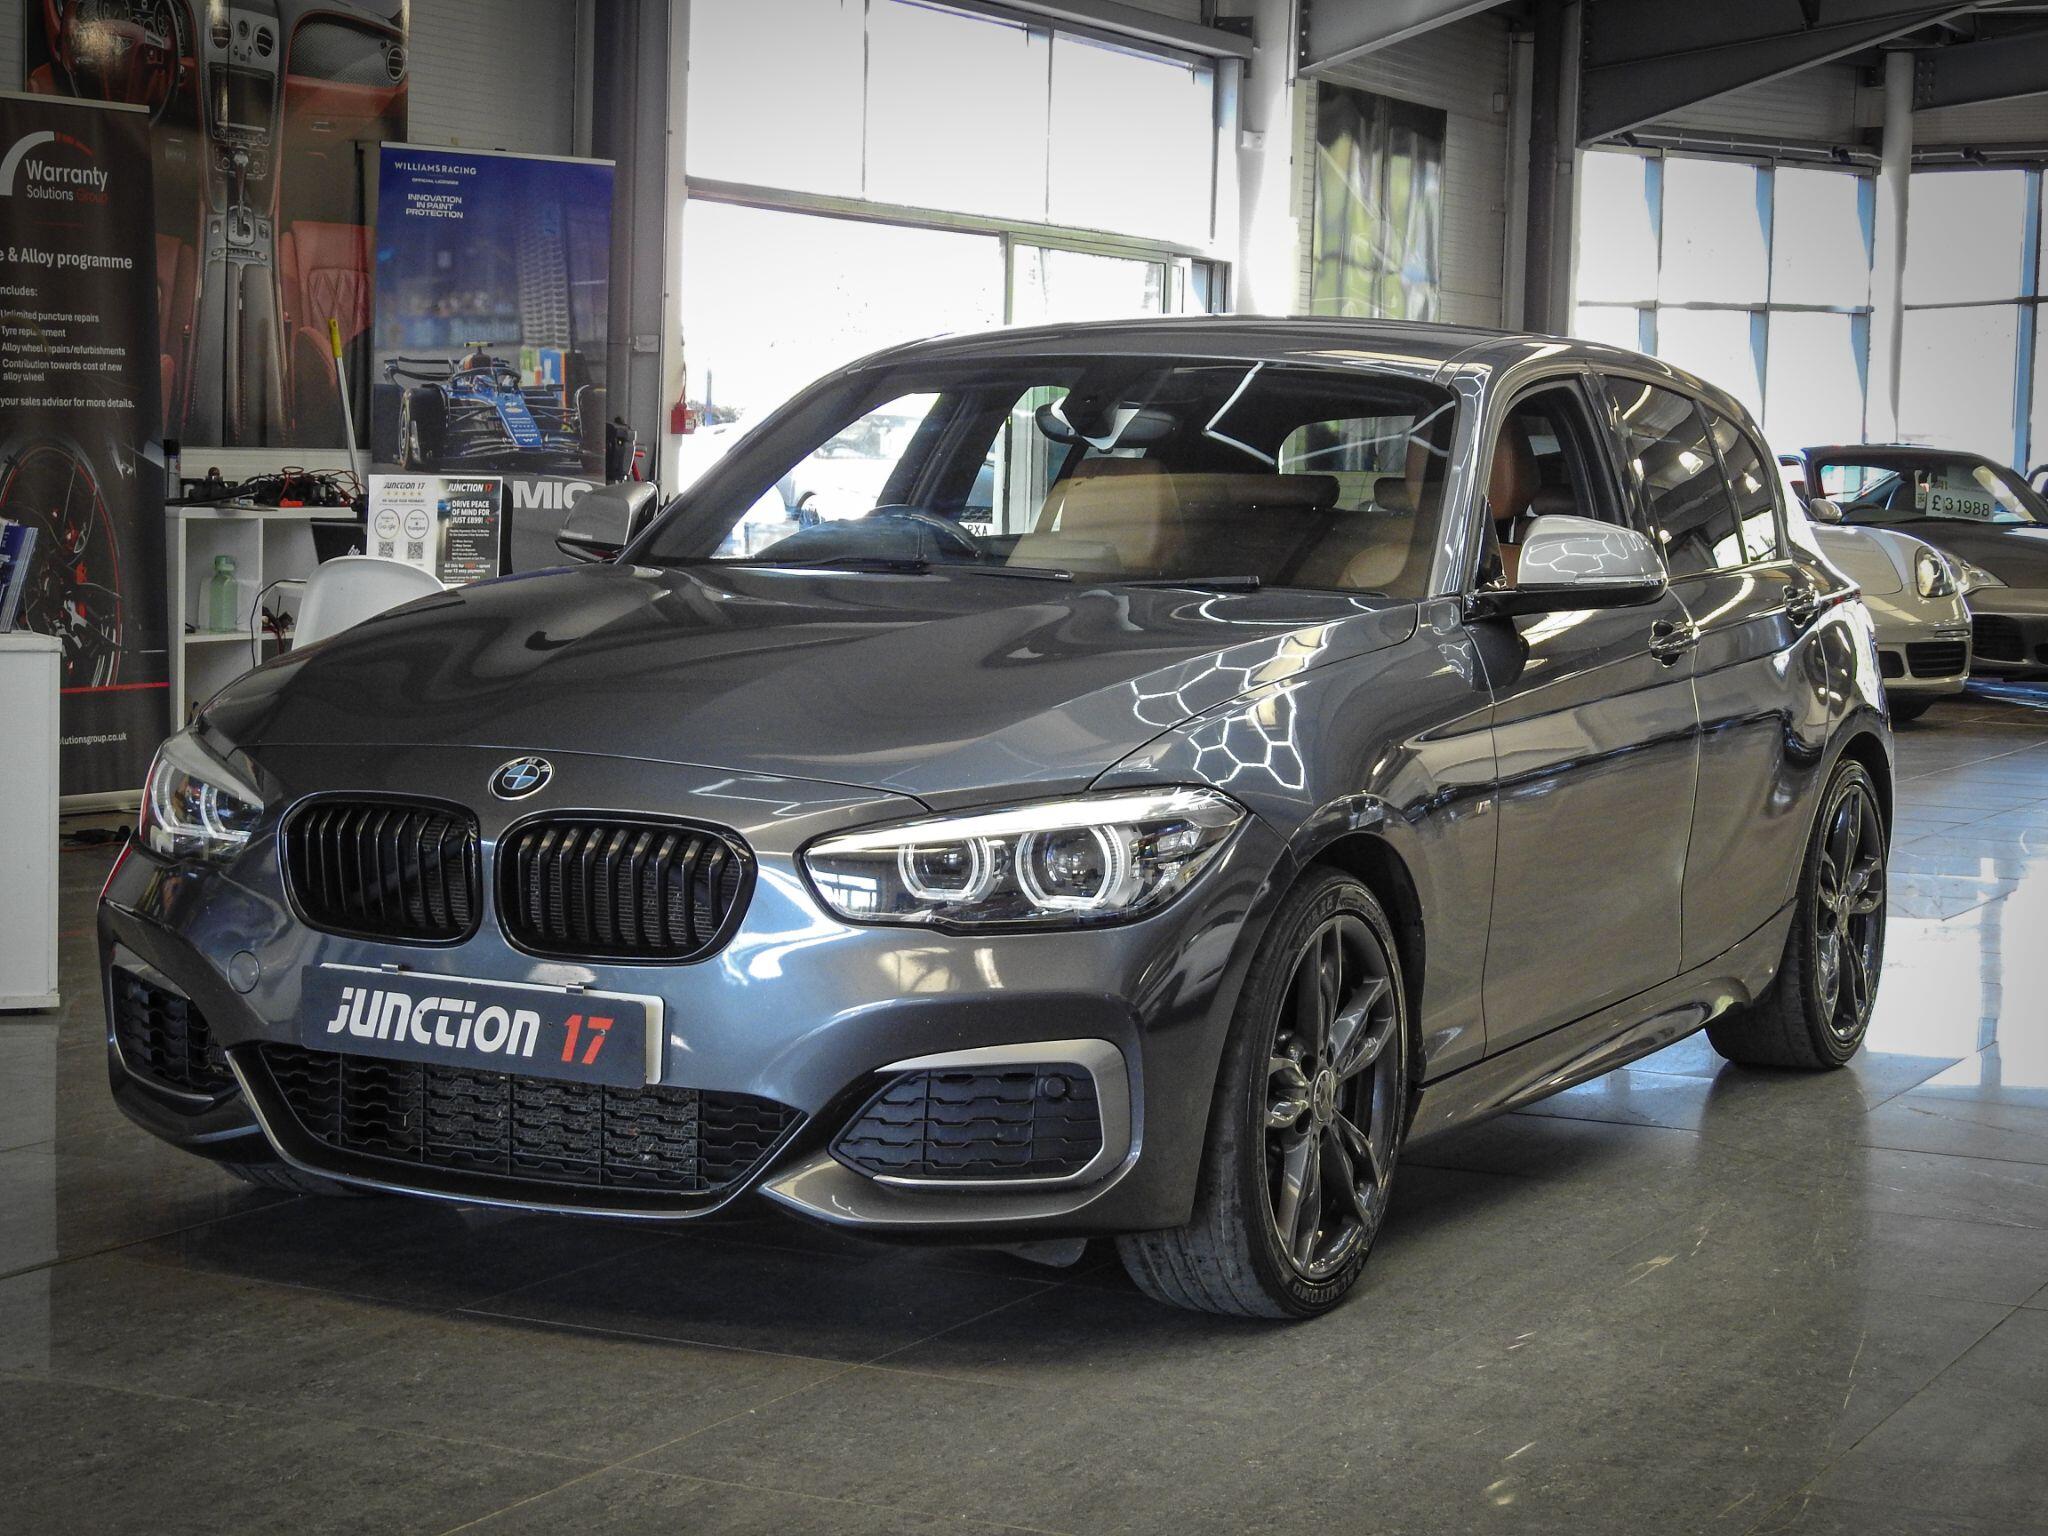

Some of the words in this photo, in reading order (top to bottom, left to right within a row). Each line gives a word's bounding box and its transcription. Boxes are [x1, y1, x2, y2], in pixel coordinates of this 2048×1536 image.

[26, 159, 108, 192] Warranty
[26, 184, 74, 201] Solutions
[76, 187, 109, 205] Group
[408, 193, 462, 204] INNOVATION
[426, 202, 454, 210] PAINT
[405, 208, 464, 218] PROTECTION
[8, 246, 18, 262] &
[21, 247, 54, 267] Alloy
[57, 252, 133, 270] programme
[38, 312, 73, 322] puncture
[74, 313, 100, 323] repairs
[1, 325, 18, 336] Tyre
[19, 327, 66, 338] replement
[1, 342, 20, 354] Alloy
[22, 343, 43, 353] wheel
[44, 343, 126, 356] rpairs/refurbishments
[2, 358, 49, 369] Contribution
[50, 360, 81, 370] towards
[82, 362, 98, 371] cost
[99, 361, 107, 371] of
[107, 363, 123, 372] new
[3, 371, 22, 383] alloy
[22, 372, 45, 381] wheel
[1, 397, 19, 408] your
[20, 396, 40, 407] sales
[42, 396, 72, 407] advisor
[73, 396, 85, 407] for
[86, 398, 106, 408] more
[107, 398, 135, 409] details.
[447, 483, 484, 493] JUNCTION
[452, 500, 470, 508] DRIVE
[471, 500, 490, 508] PEACE
[1931, 494, 1990, 517] £31988
[451, 508, 461, 516] OF
[561, 1014, 614, 1065] 17
